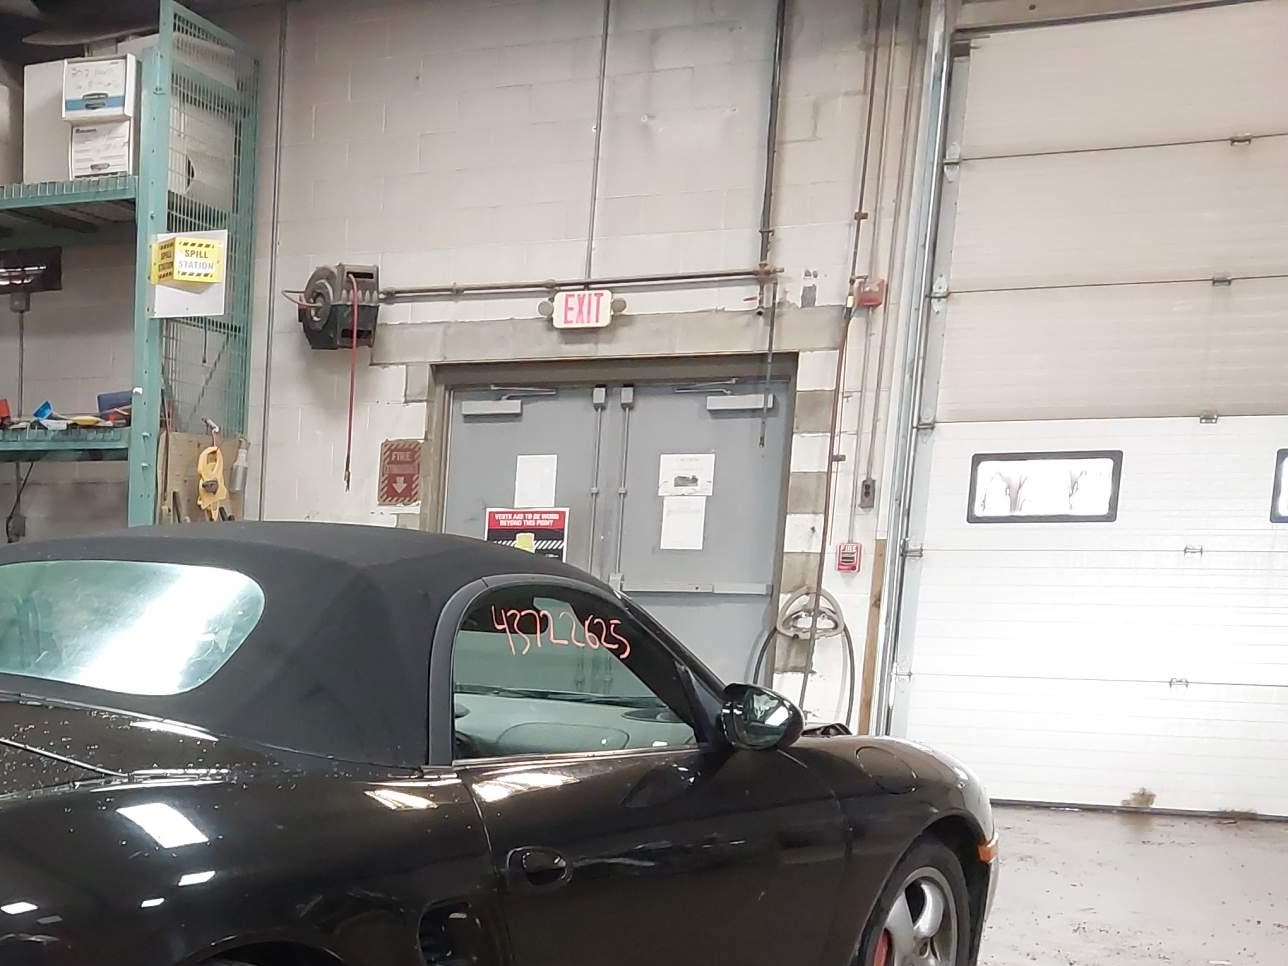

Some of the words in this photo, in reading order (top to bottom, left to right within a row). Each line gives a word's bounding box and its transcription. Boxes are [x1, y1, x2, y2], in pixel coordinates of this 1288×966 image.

[185, 249, 208, 259] SPILL
[178, 261, 214, 270] STATION
[563, 292, 604, 324] EXIT
[491, 604, 631, 659] 43722625
